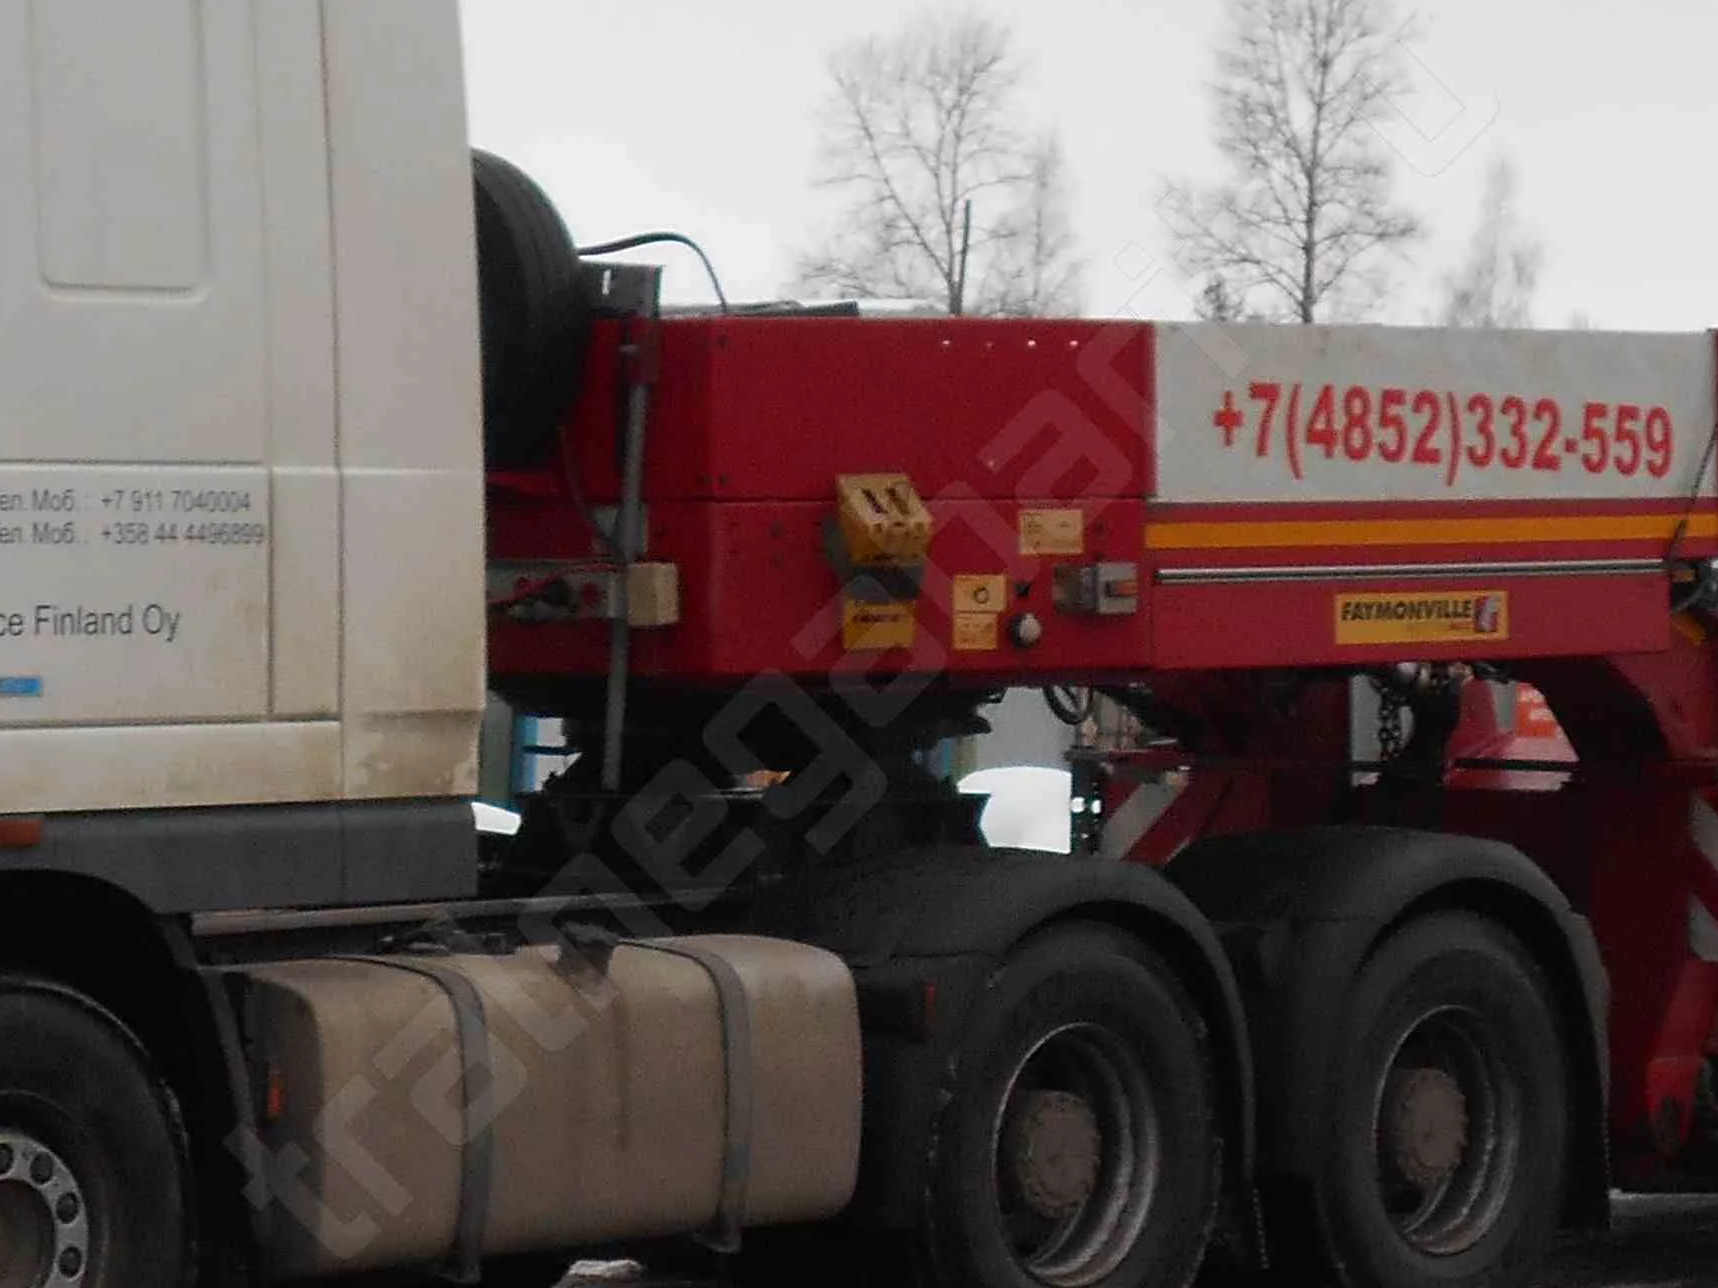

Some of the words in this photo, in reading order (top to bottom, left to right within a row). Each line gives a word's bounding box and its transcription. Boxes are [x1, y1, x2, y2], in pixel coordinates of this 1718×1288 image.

[1214, 380, 1674, 487] +7(4852)332-559
[101, 489, 124, 511] +7
[132, 489, 163, 512] 911
[35, 603, 133, 637] Finland
[142, 603, 180, 643] Oy
[1340, 599, 1472, 621] FAYMONVILLE
